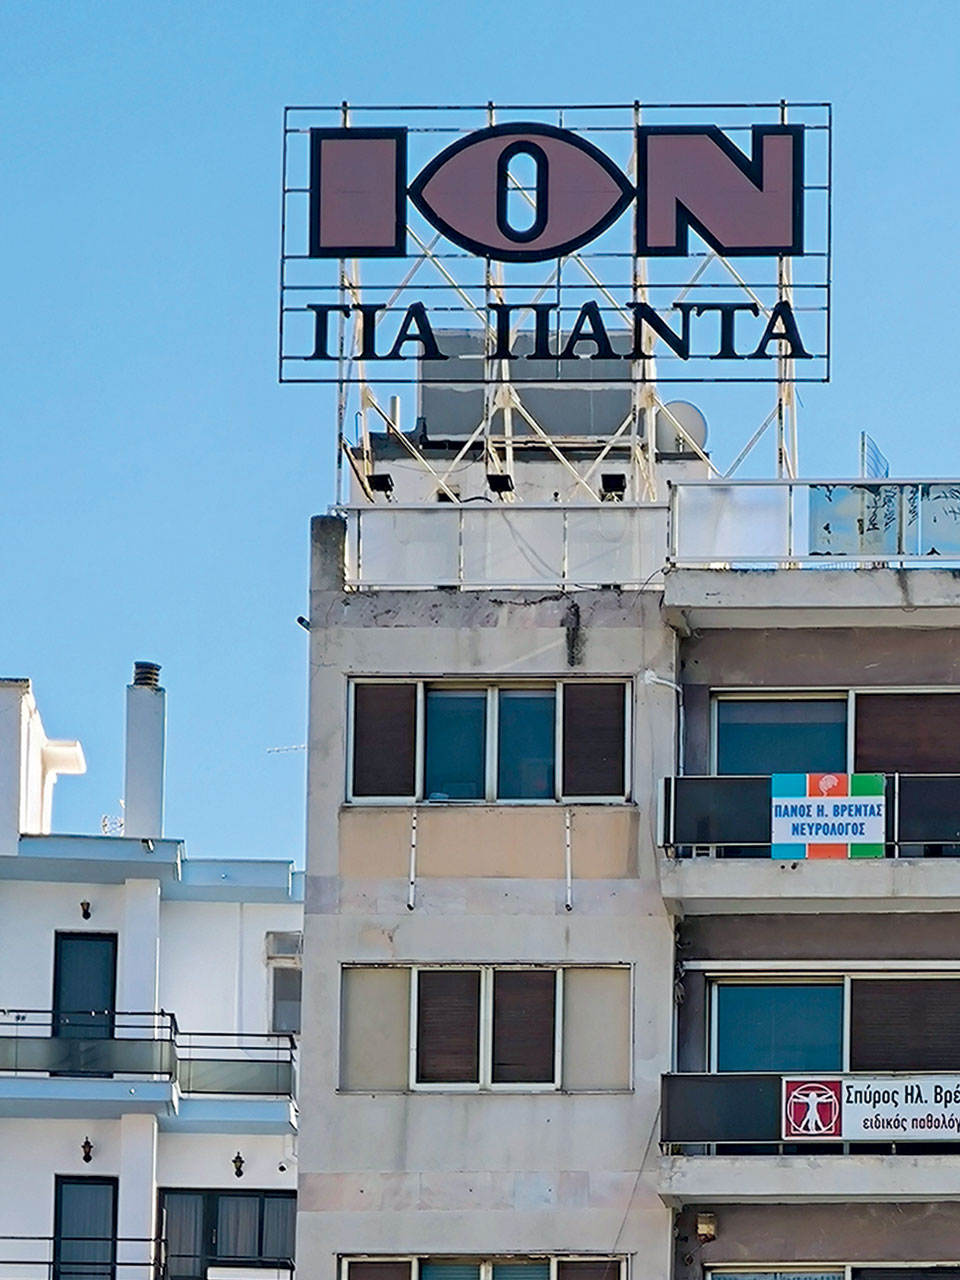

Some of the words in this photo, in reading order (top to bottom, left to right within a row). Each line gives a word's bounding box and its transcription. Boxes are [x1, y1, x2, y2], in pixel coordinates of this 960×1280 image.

[304, 301, 449, 361] ΓΙΑ
[486, 301, 814, 361] ΠΑΝΤΑ
[774, 804, 813, 818] ΠΑΝΟΣ
[816, 804, 829, 818] Η.
[833, 804, 883, 818] ΒΡΕΝΤΑΣ
[791, 822, 866, 836] ΝΕΥΡΟΛΟΓΟΣ
[845, 1084, 899, 1108] Σπύρος
[904, 1084, 929, 1104] Ηλ.
[862, 1114, 908, 1134] ειδικός
